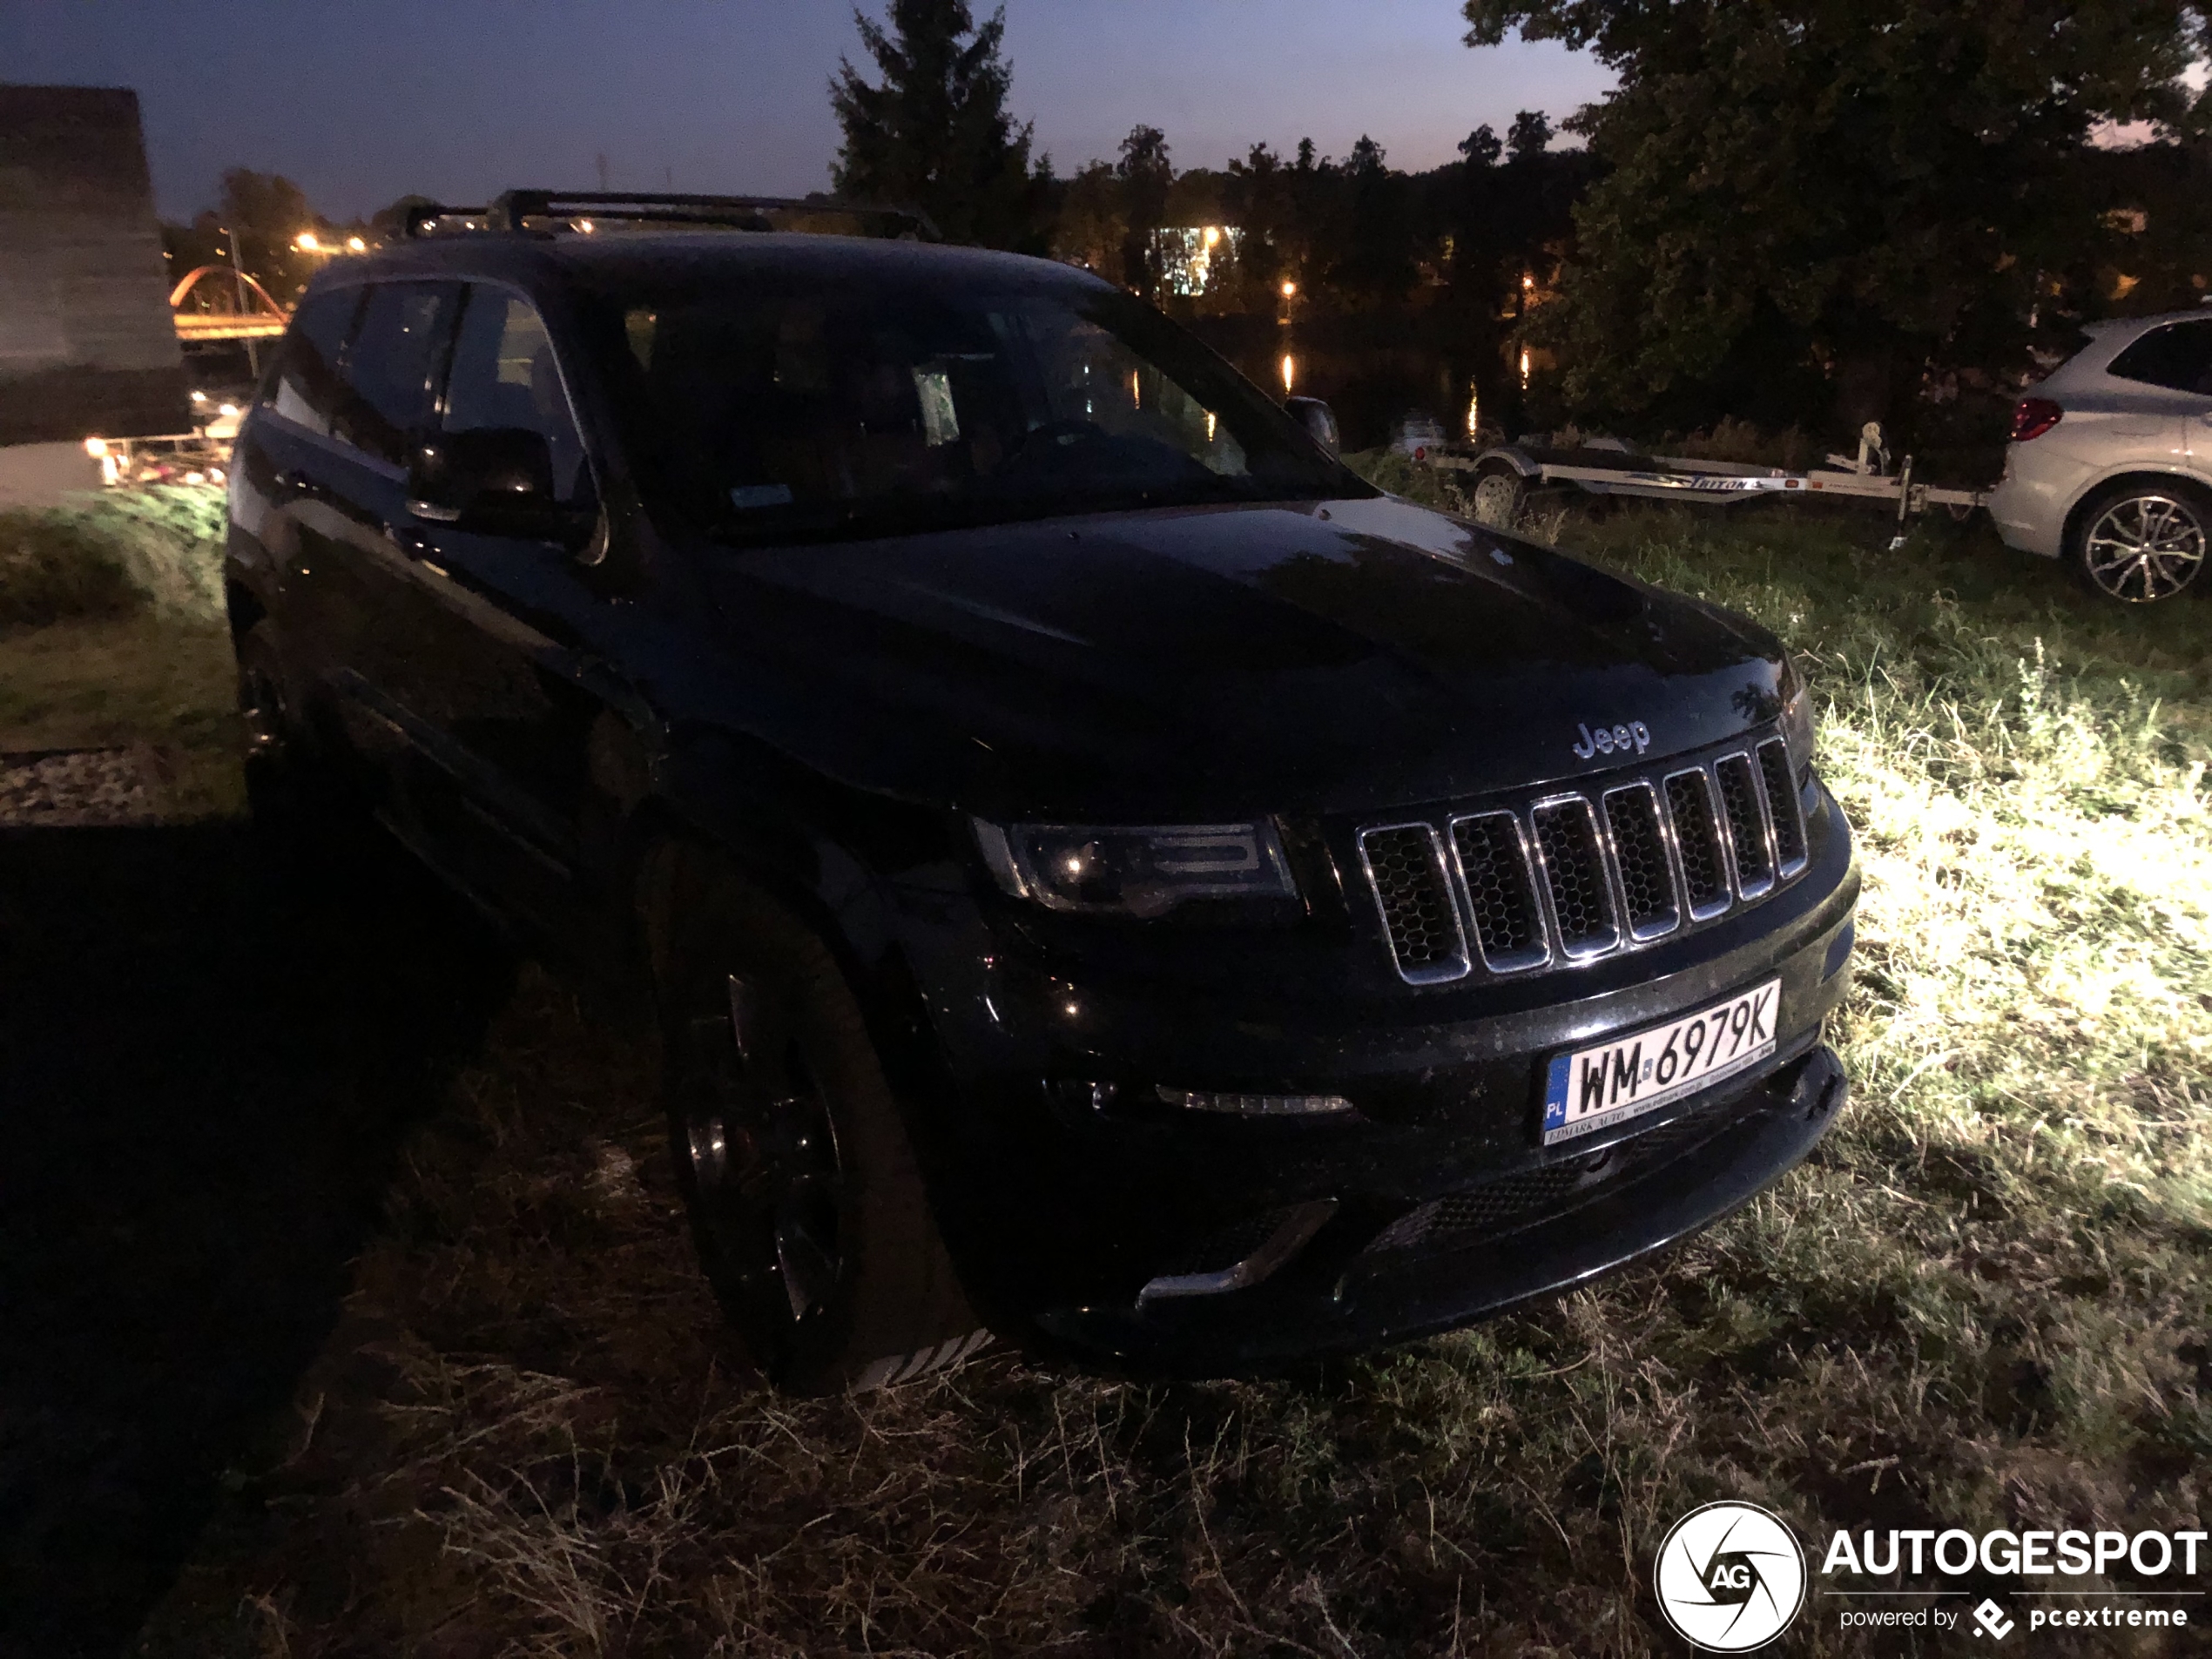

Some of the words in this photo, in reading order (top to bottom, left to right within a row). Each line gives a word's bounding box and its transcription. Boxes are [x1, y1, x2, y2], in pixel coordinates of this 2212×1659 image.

[1572, 720, 1650, 759] Jeep
[1579, 1041, 1642, 1114] WM
[1656, 986, 1773, 1086] 6979K
[1547, 1101, 1563, 1119] PL
[1548, 1123, 1593, 1143] EDMARK
[1597, 1111, 1625, 1128] AUTO
